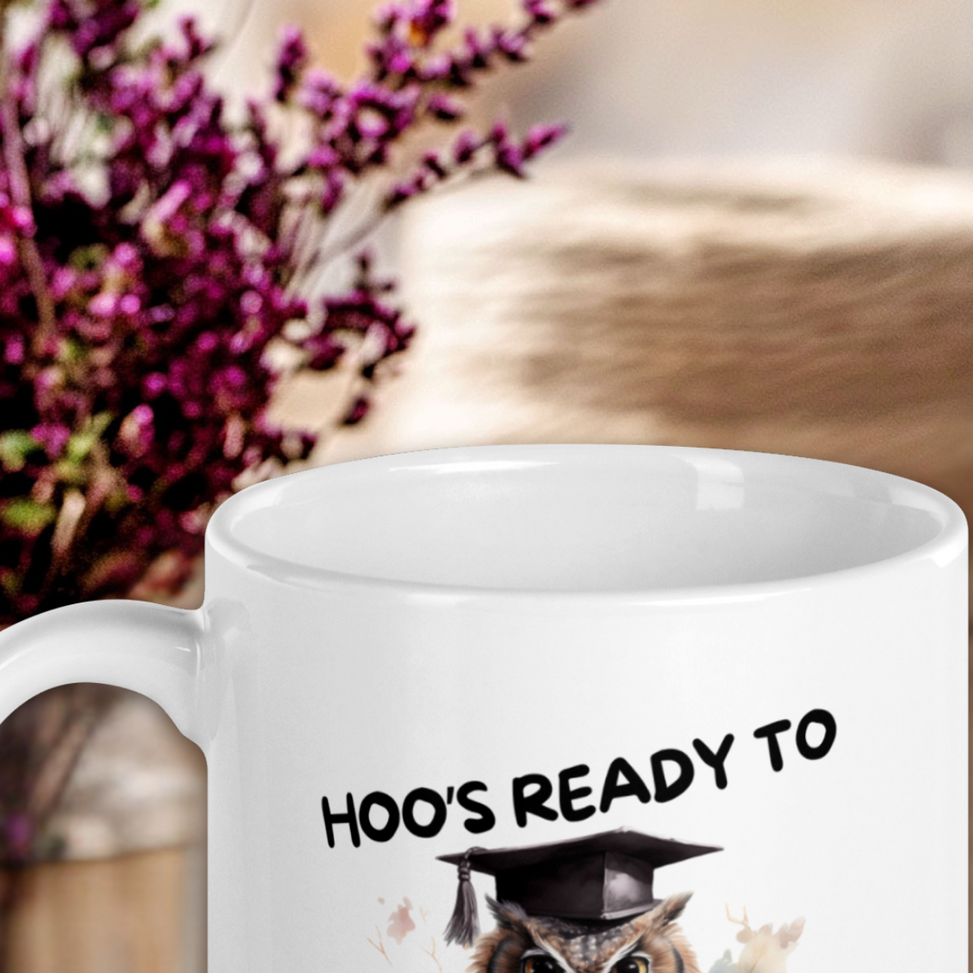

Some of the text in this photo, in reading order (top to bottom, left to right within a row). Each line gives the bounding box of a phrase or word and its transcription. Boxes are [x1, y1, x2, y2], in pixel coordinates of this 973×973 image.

[321, 708, 837, 849] HOO'S READY TO
